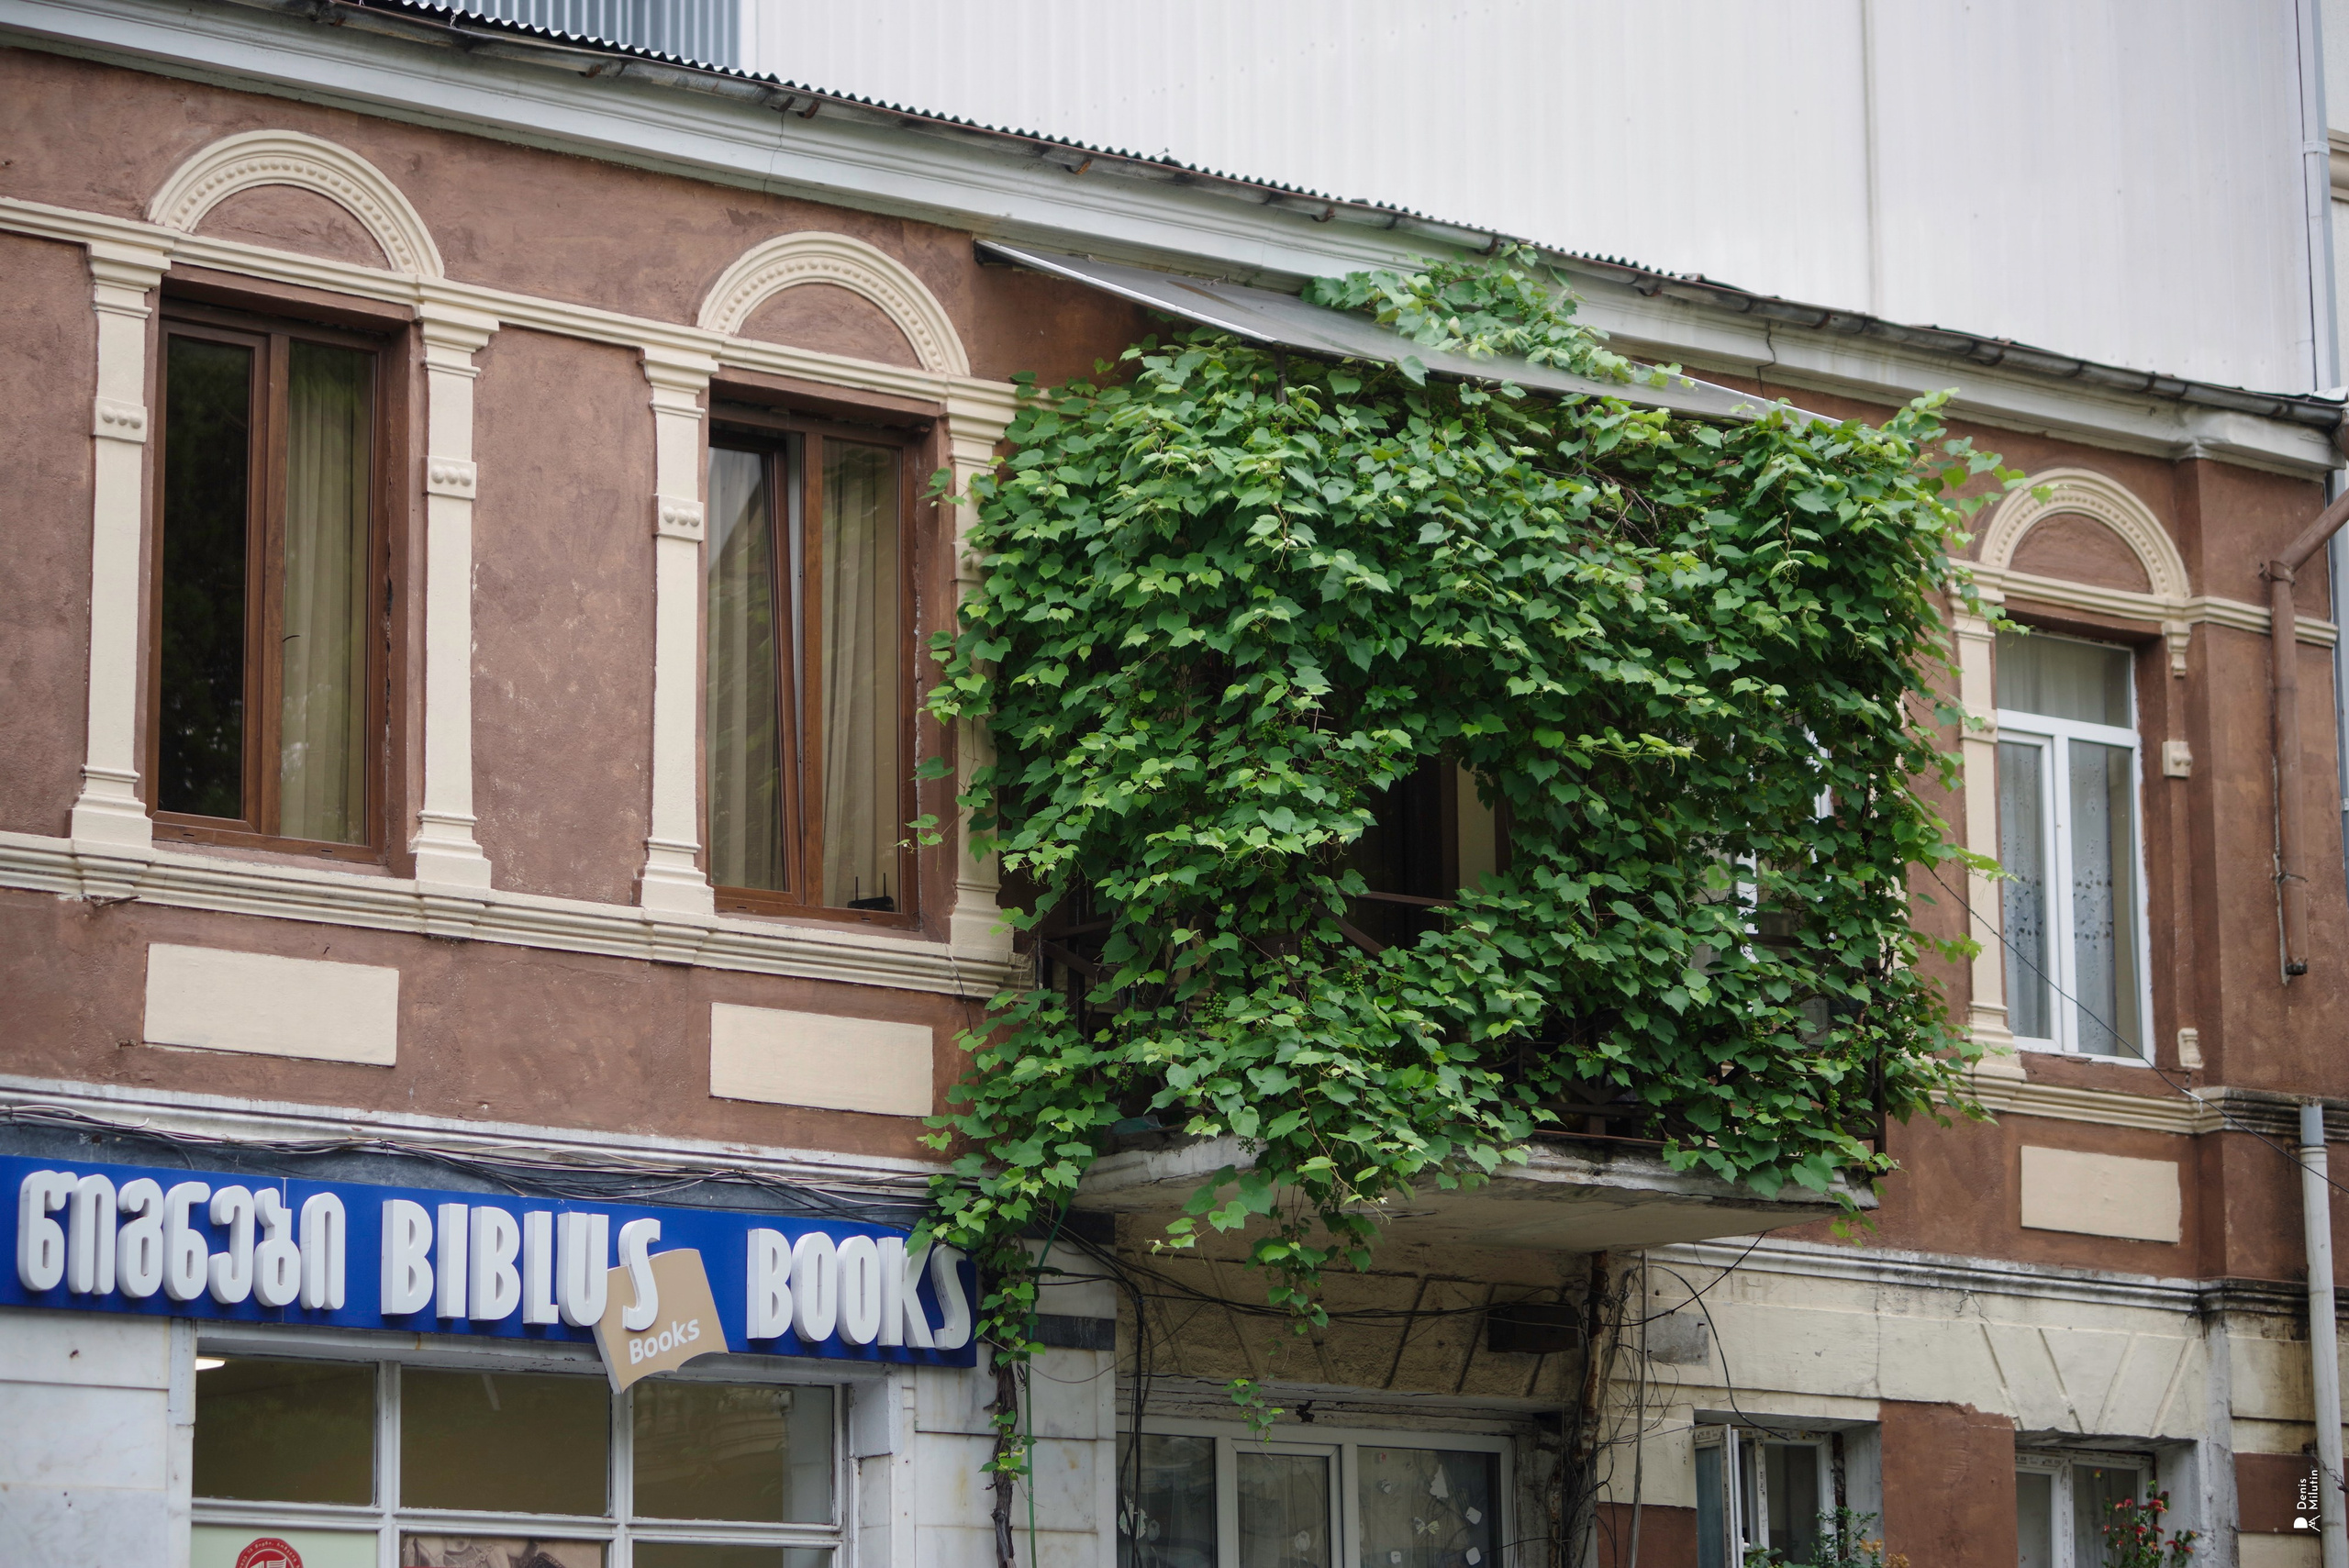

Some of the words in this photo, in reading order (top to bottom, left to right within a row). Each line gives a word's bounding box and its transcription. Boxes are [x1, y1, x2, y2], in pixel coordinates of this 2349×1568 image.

[18, 1170, 346, 1310] წიგნები
[381, 1199, 661, 1331] BIBLUS
[747, 1229, 971, 1351] BOOKS
[629, 1318, 700, 1365] Books
